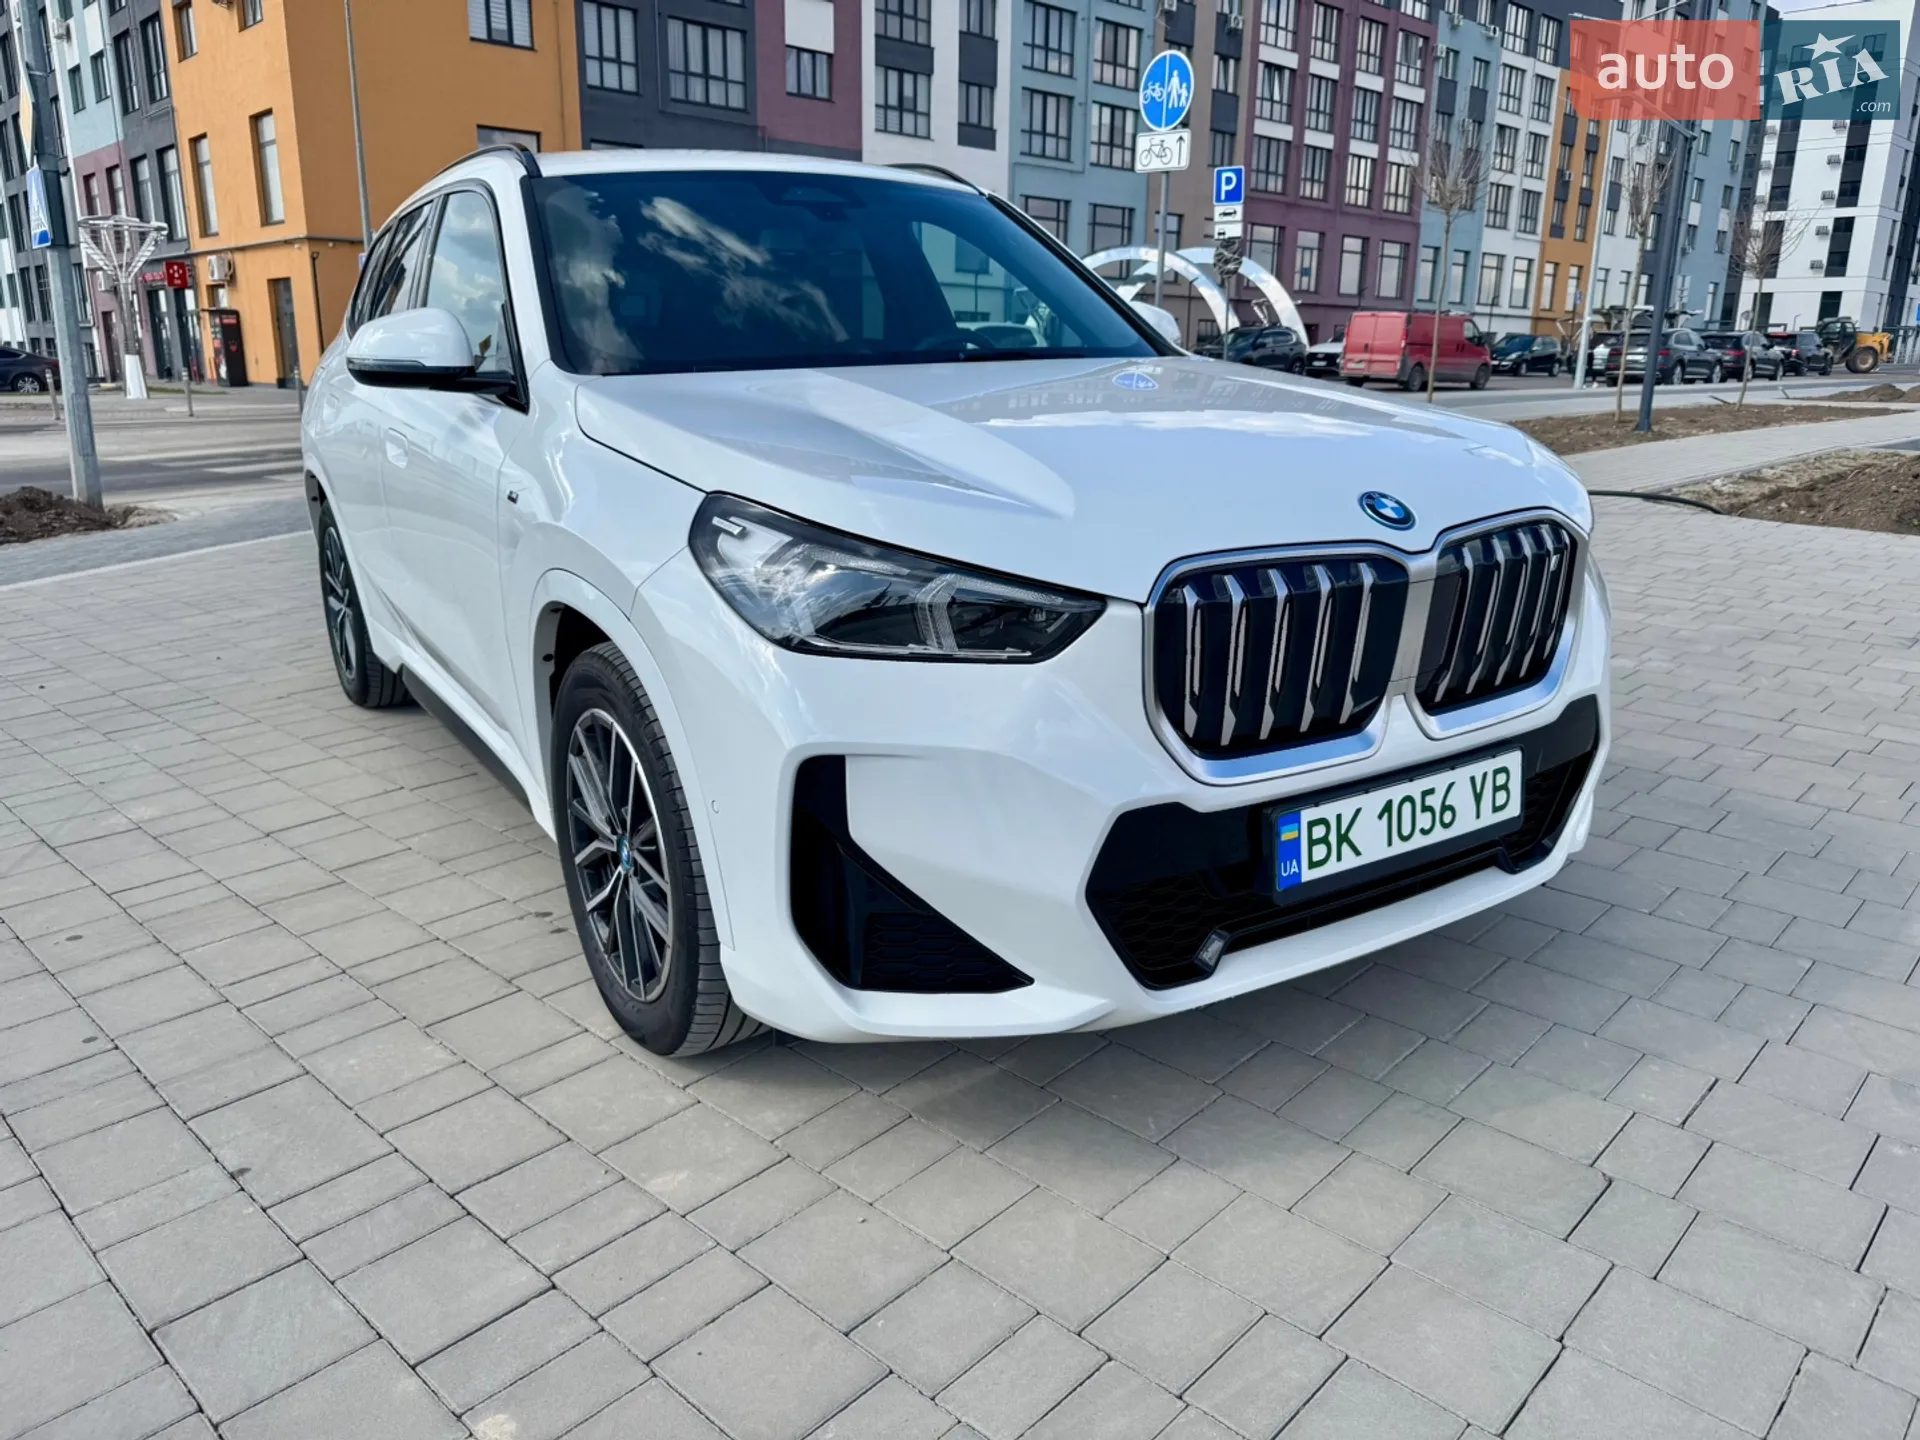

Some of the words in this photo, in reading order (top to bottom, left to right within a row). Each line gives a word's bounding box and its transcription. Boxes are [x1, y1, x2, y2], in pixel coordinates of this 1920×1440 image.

[1220, 171, 1237, 200] P
[1307, 807, 1362, 870] BK
[1377, 782, 1456, 847] 1056
[1470, 766, 1511, 820] YB
[1281, 859, 1299, 877] UA
